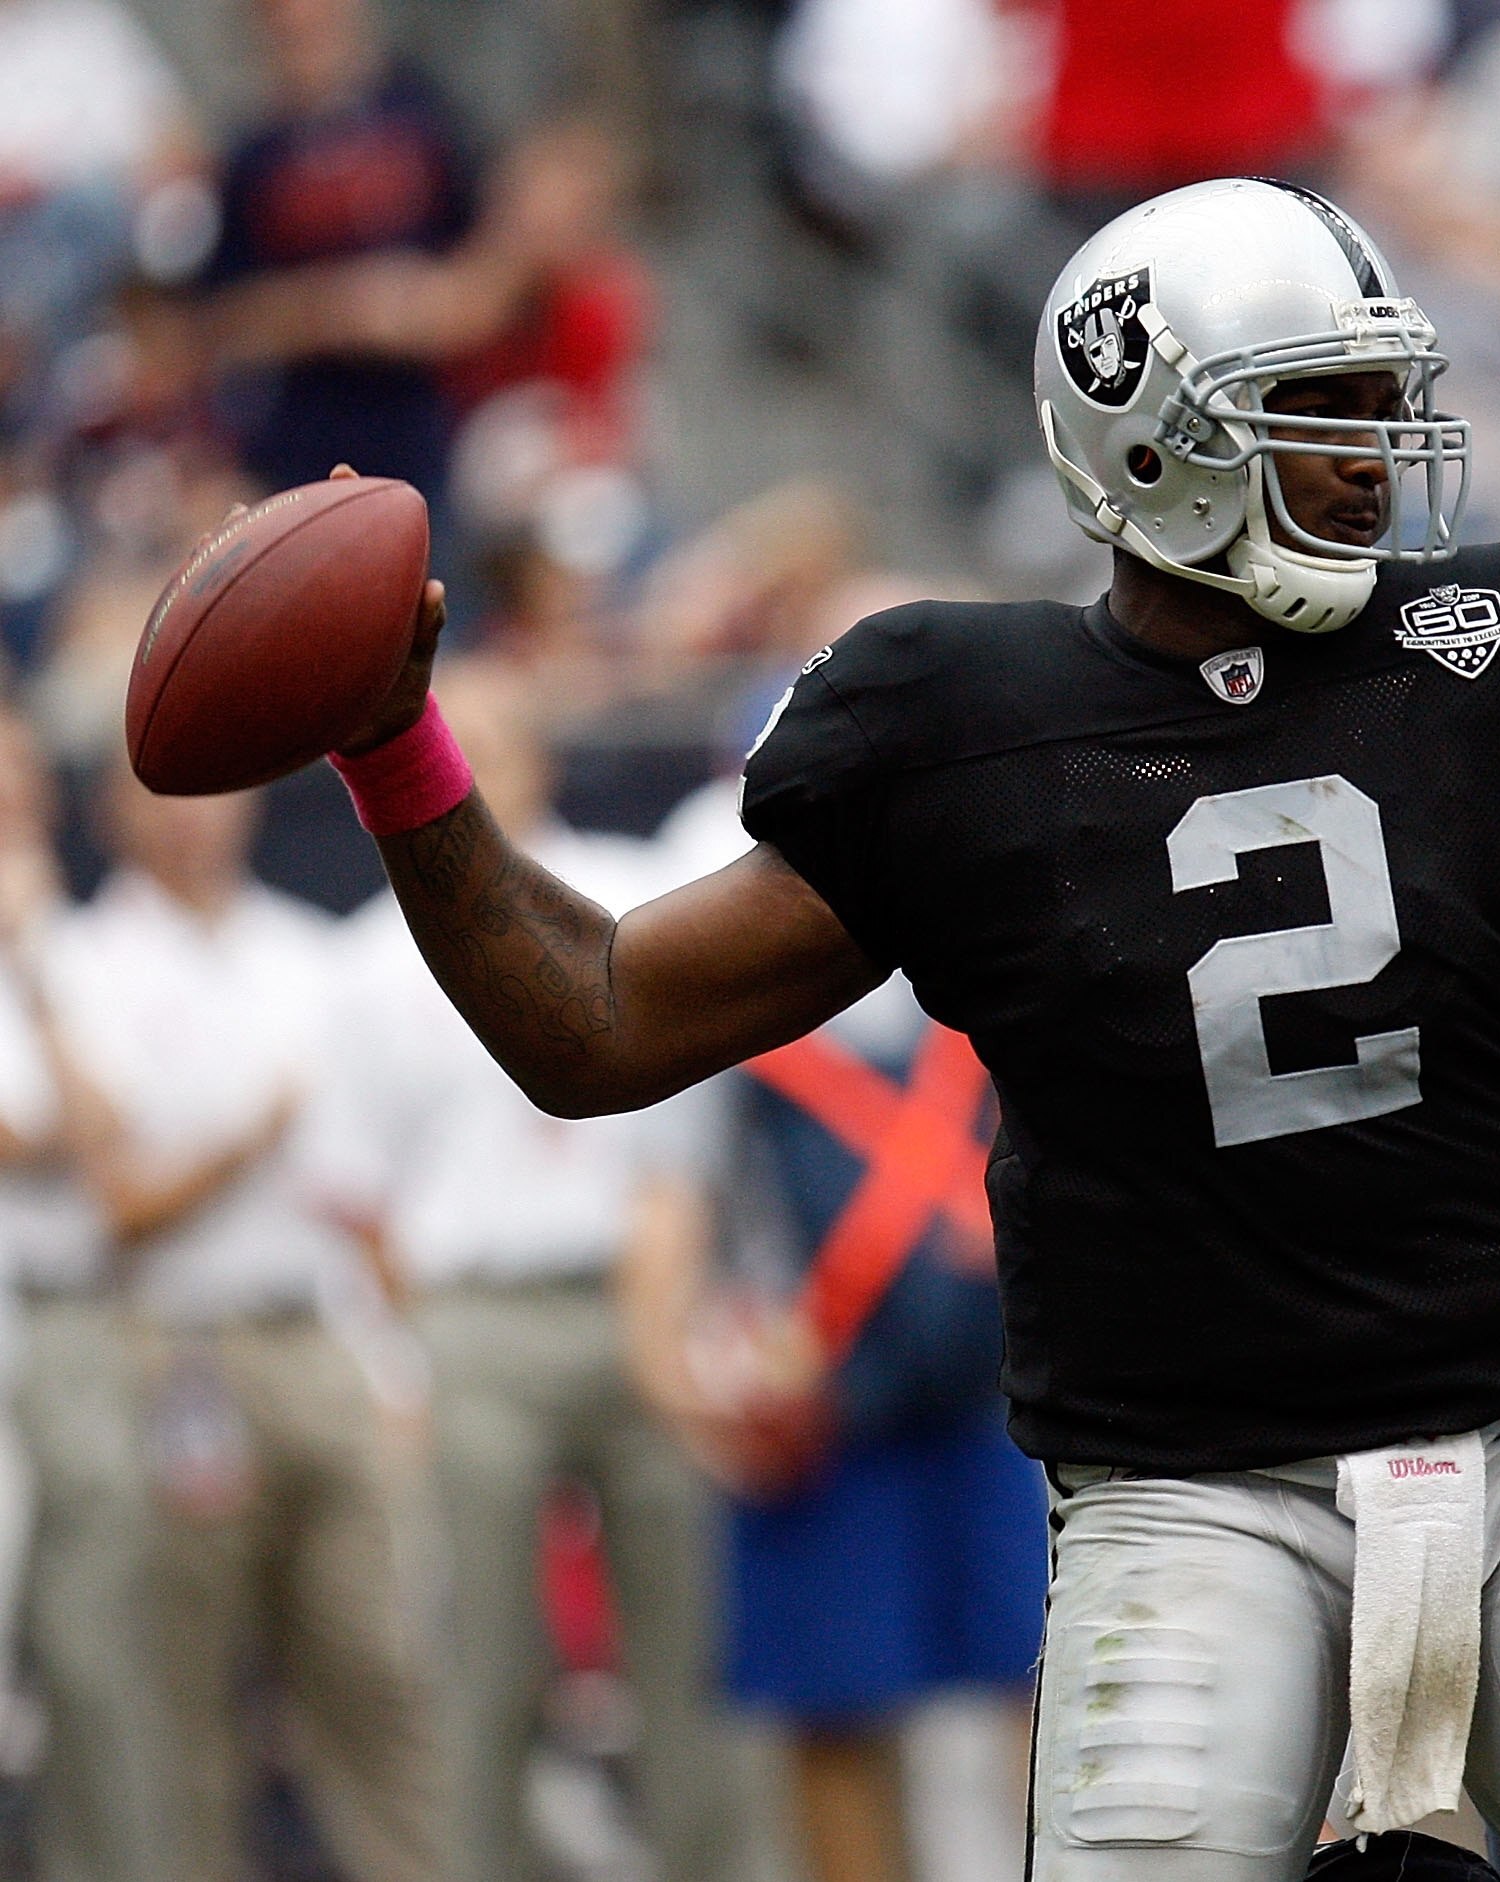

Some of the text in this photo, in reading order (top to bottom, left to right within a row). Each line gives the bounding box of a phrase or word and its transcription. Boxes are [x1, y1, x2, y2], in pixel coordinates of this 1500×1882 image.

[1063, 274, 1139, 326] RAIDERS
[1412, 599, 1499, 636] 50
[1167, 774, 1423, 1148] 2
[1387, 1457, 1463, 1479] Wilson
